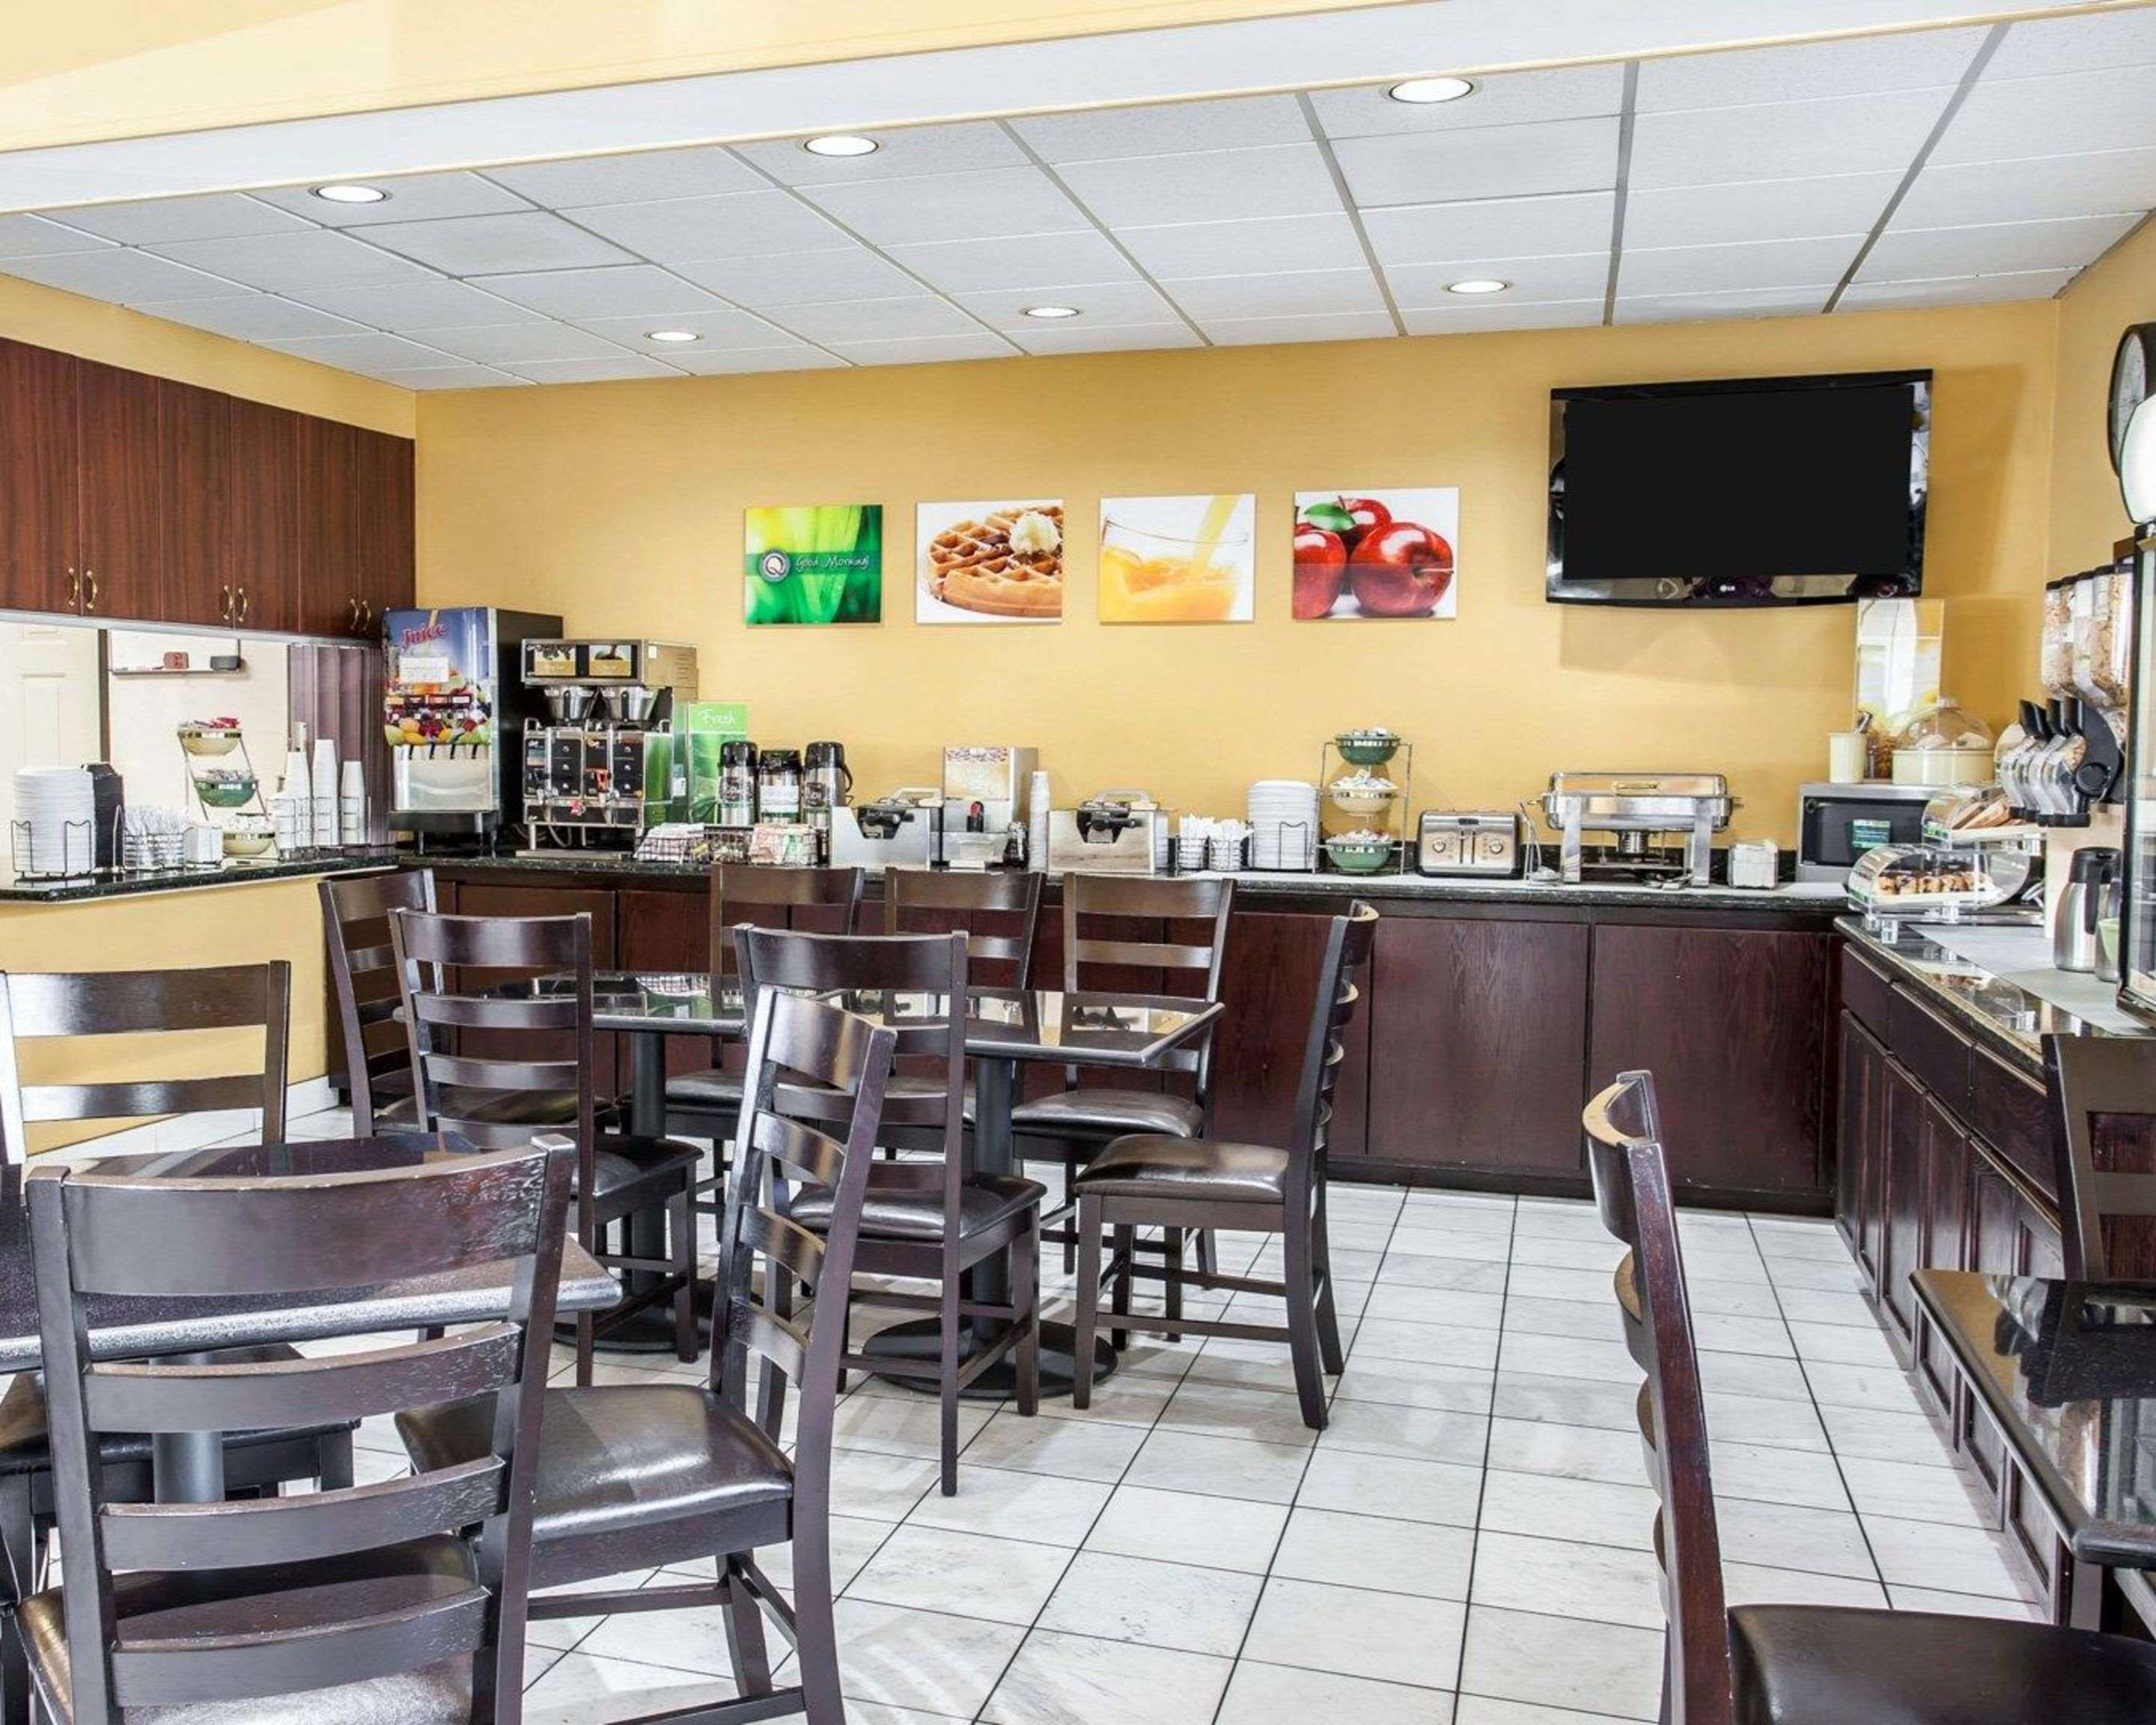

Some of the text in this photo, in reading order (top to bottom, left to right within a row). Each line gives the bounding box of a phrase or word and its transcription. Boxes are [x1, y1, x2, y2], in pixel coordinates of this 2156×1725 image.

[765, 556, 784, 576] Q
[796, 556, 869, 572] Good Morning
